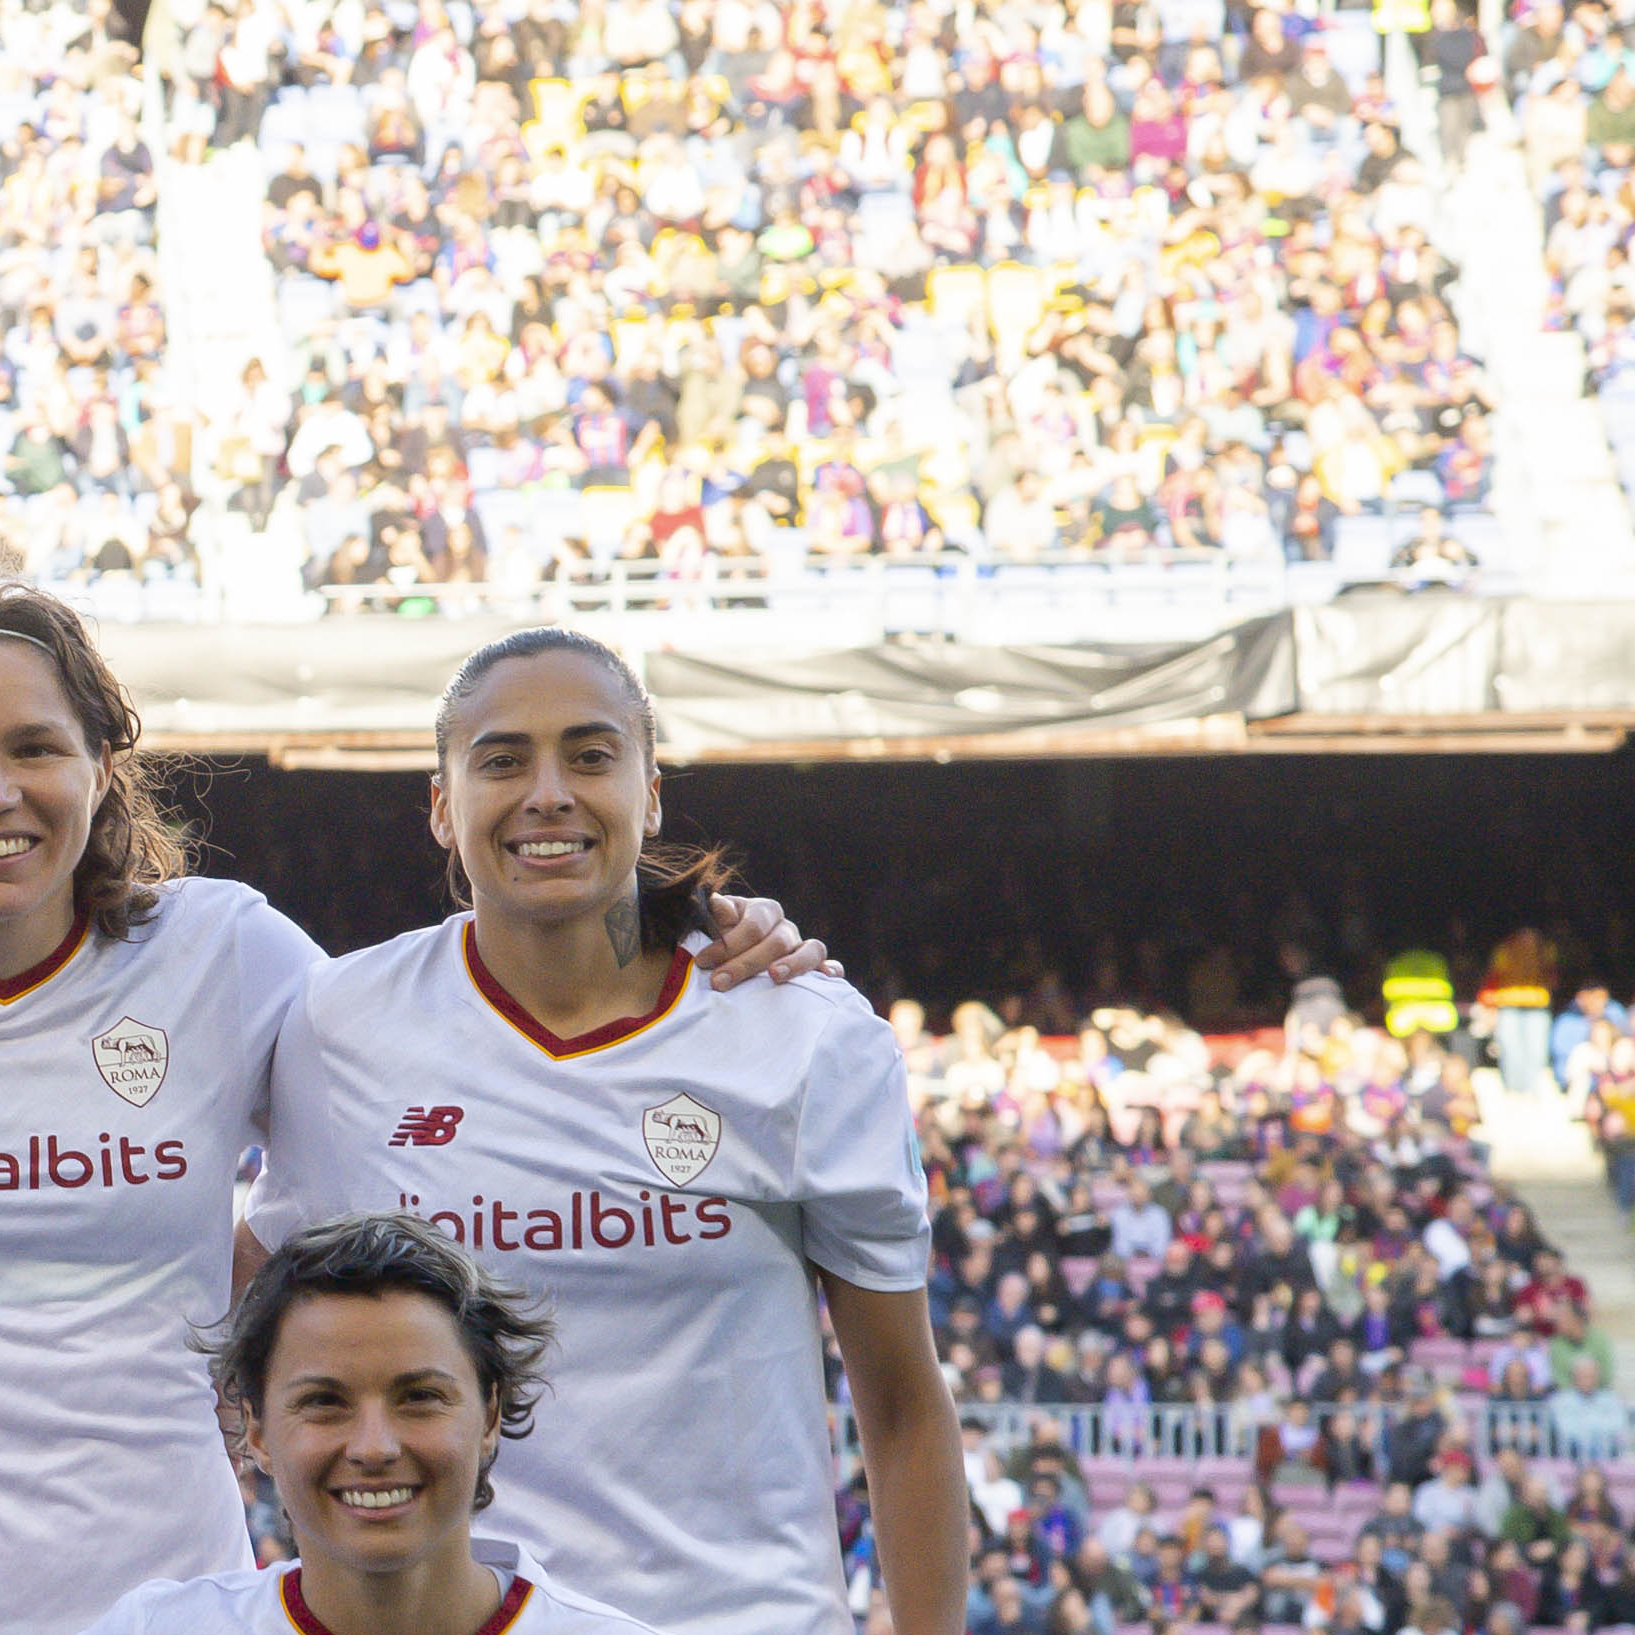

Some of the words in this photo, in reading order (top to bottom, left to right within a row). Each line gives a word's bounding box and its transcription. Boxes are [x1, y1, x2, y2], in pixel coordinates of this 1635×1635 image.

[109, 1066, 162, 1084] ROMA
[128, 1085, 148, 1096] 1927
[654, 1143, 708, 1161] ROMA
